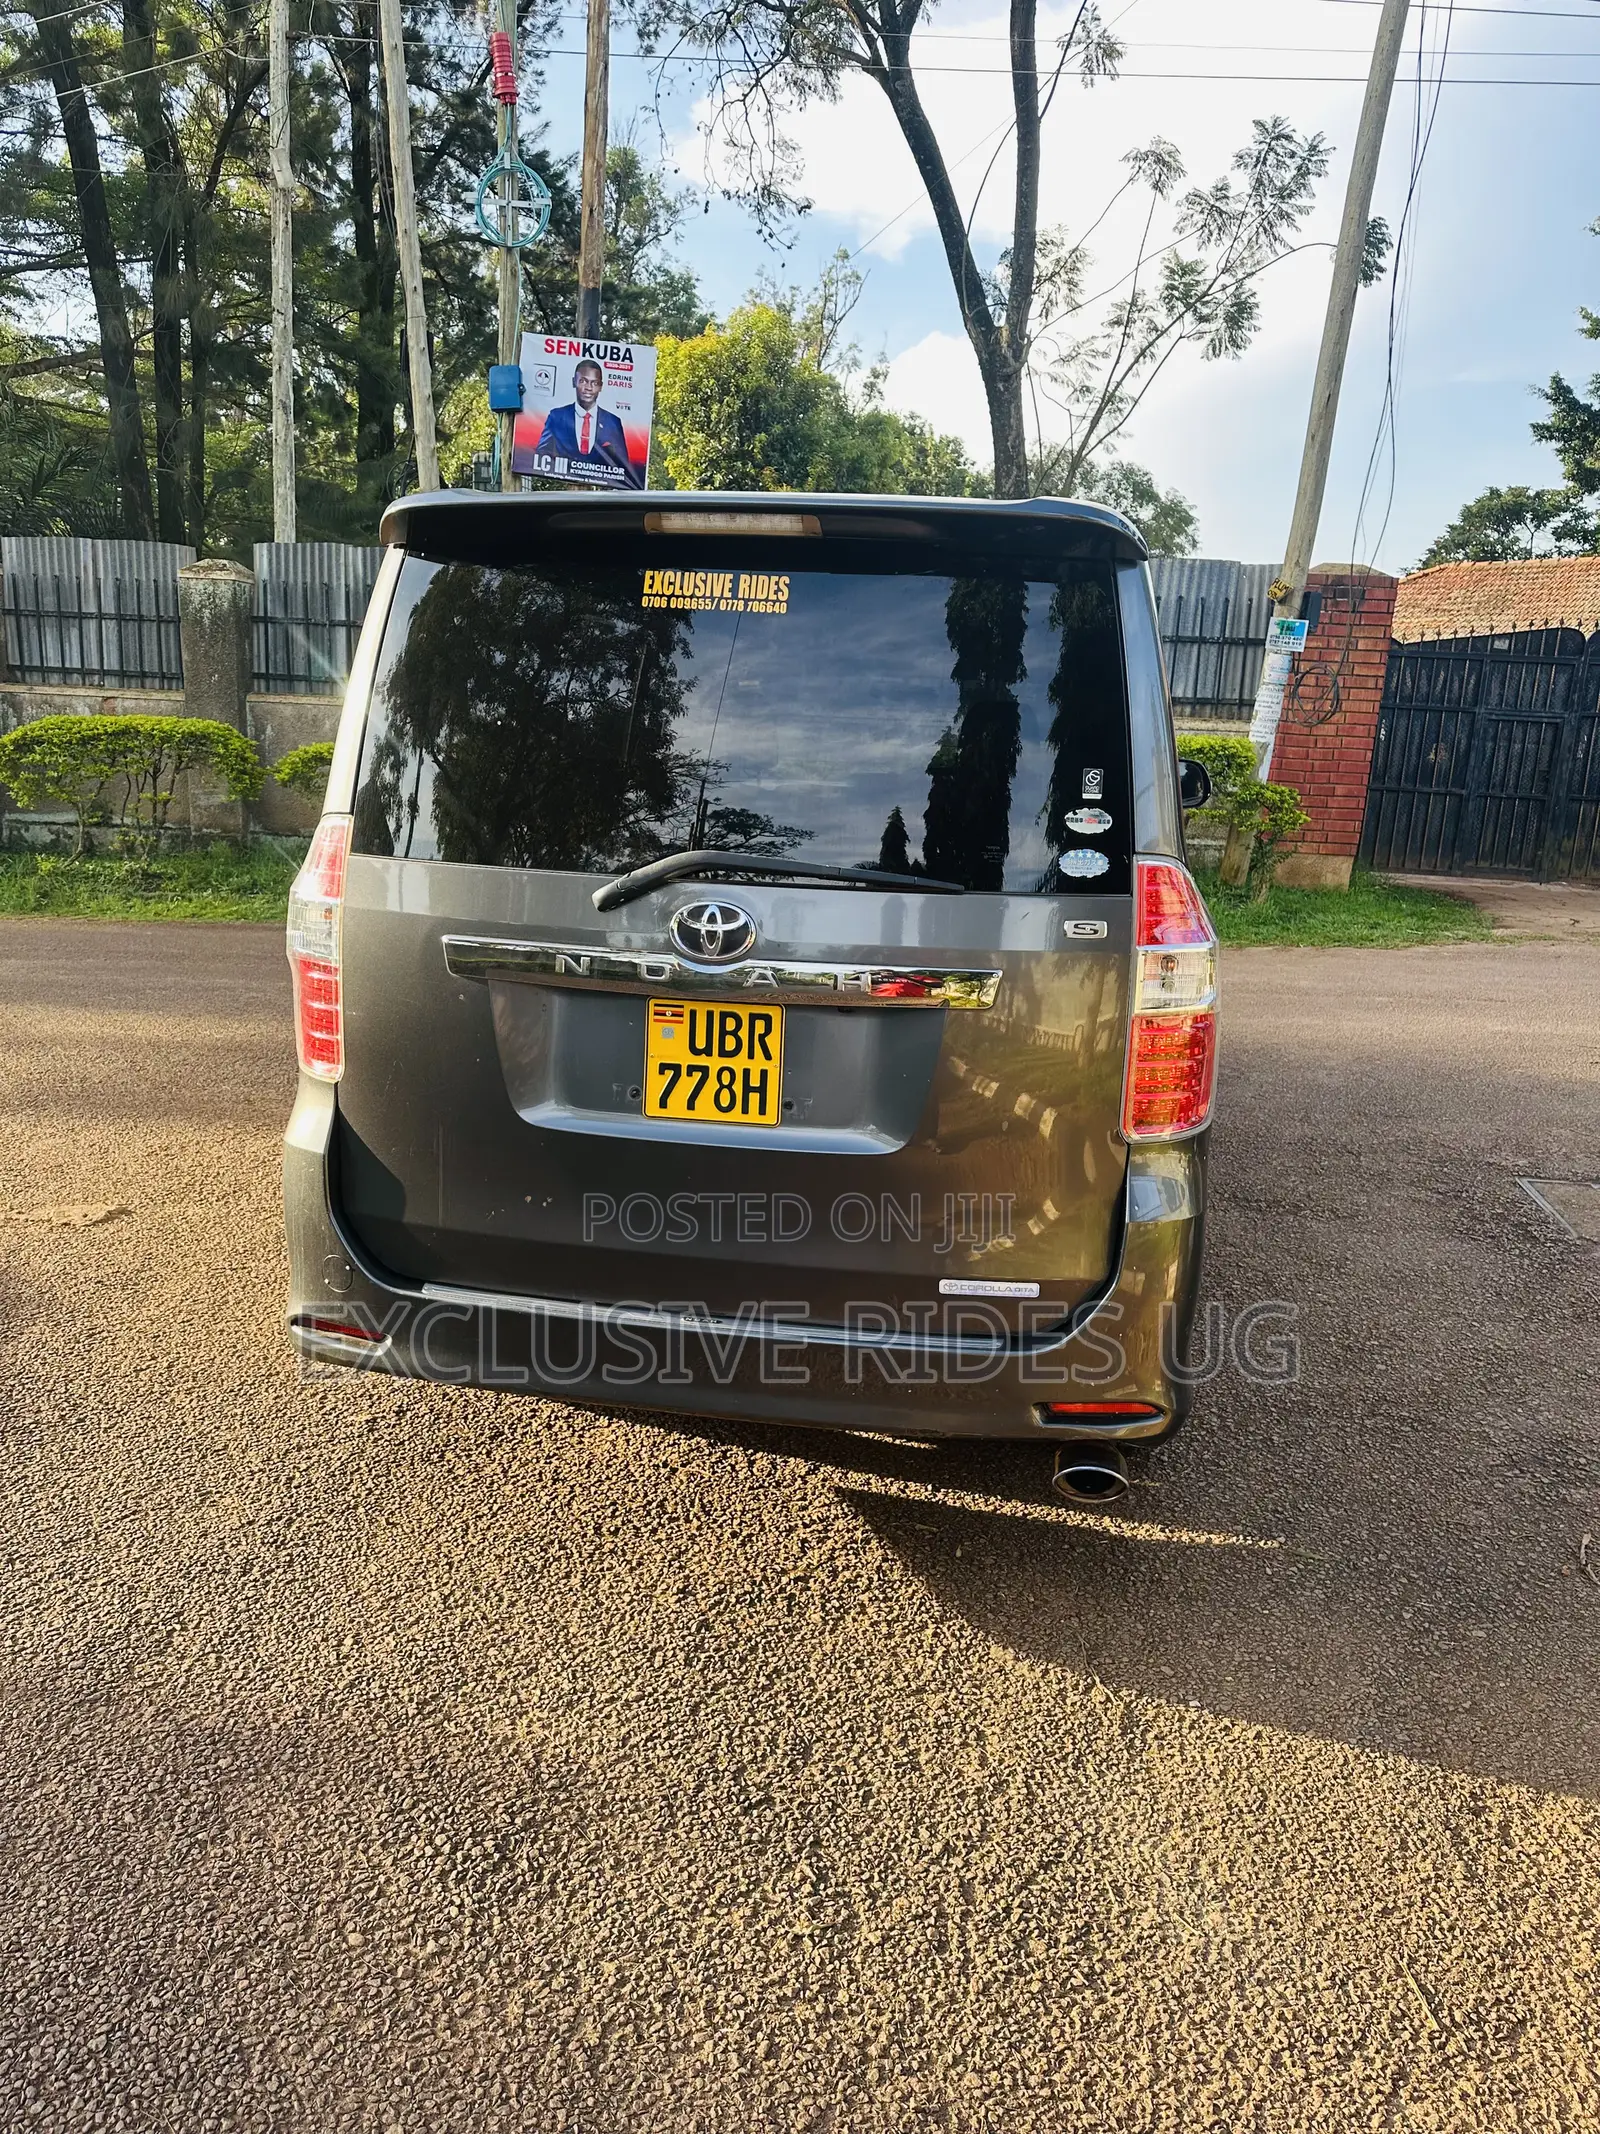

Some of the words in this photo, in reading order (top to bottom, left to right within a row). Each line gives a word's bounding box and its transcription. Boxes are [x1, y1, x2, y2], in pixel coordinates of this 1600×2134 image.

[544, 338, 634, 363] SENKUBA
[607, 380, 633, 389] DARIS
[608, 373, 633, 382] EDRINE
[533, 453, 551, 472] LC
[571, 461, 625, 475] COUNCILLOR
[603, 473, 625, 481] PARISH
[643, 570, 734, 598] EXCLUSIVE
[738, 574, 790, 601] RIDES
[641, 595, 668, 608] 0706
[719, 599, 745, 612] 0778
[746, 601, 788, 614] 706640
[688, 1008, 773, 1062] UBR
[658, 1062, 769, 1116] 778H
[960, 1284, 1014, 1293] COROLLA
